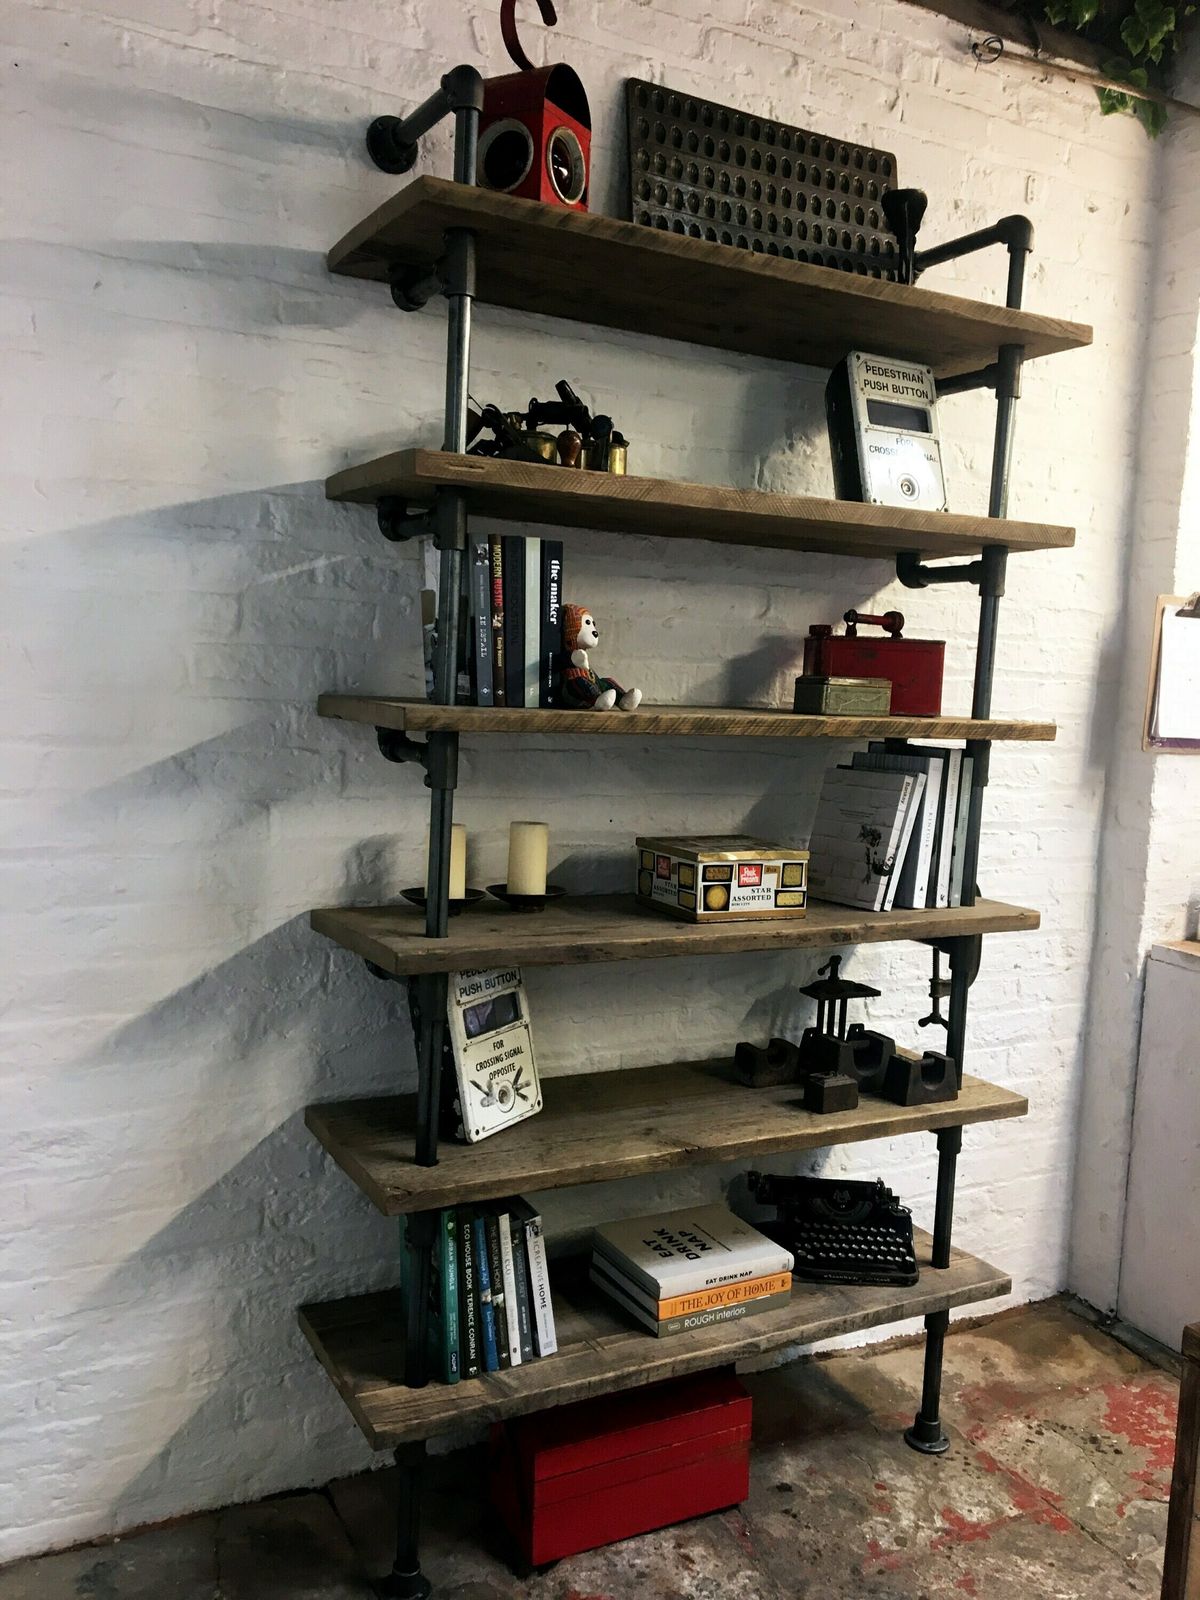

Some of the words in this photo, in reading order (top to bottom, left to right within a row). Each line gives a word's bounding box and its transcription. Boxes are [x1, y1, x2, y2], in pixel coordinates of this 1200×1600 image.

[865, 364, 924, 385] PEDESTRIAN
[863, 378, 889, 393] PUSH
[892, 384, 929, 400] BUTTON
[492, 544, 503, 578] MODERN
[549, 559, 560, 581] the
[493, 577, 504, 608] RUSTIC
[549, 582, 560, 626] maker
[731, 894, 772, 902] ASSORTED
[459, 981, 483, 998] PUSH
[484, 970, 517, 990] BUTTON
[492, 1039, 505, 1051] FOR
[476, 1054, 504, 1072] CROSSING
[504, 1046, 524, 1060] SIGNAL
[489, 1063, 516, 1080] OPPOSITE
[463, 1223, 471, 1240] ECO
[678, 1230, 713, 1252] NAP
[464, 1240, 472, 1268] HOUSE
[642, 1239, 675, 1258] EAT
[653, 1228, 702, 1260] DRINK
[465, 1268, 473, 1291] BOOK
[705, 1277, 718, 1285] EAT
[718, 1273, 739, 1283] DRINK
[739, 1270, 753, 1278] NAP
[538, 1283, 547, 1310] HOME
[680, 1296, 703, 1312] THE
[704, 1292, 726, 1306] JOY
[726, 1287, 742, 1300] OF
[743, 1280, 776, 1297] HOME
[466, 1292, 475, 1328] TERENCE
[684, 1313, 715, 1328] ROUGH
[716, 1306, 746, 1321] interiors
[468, 1328, 477, 1360] CONRAN
